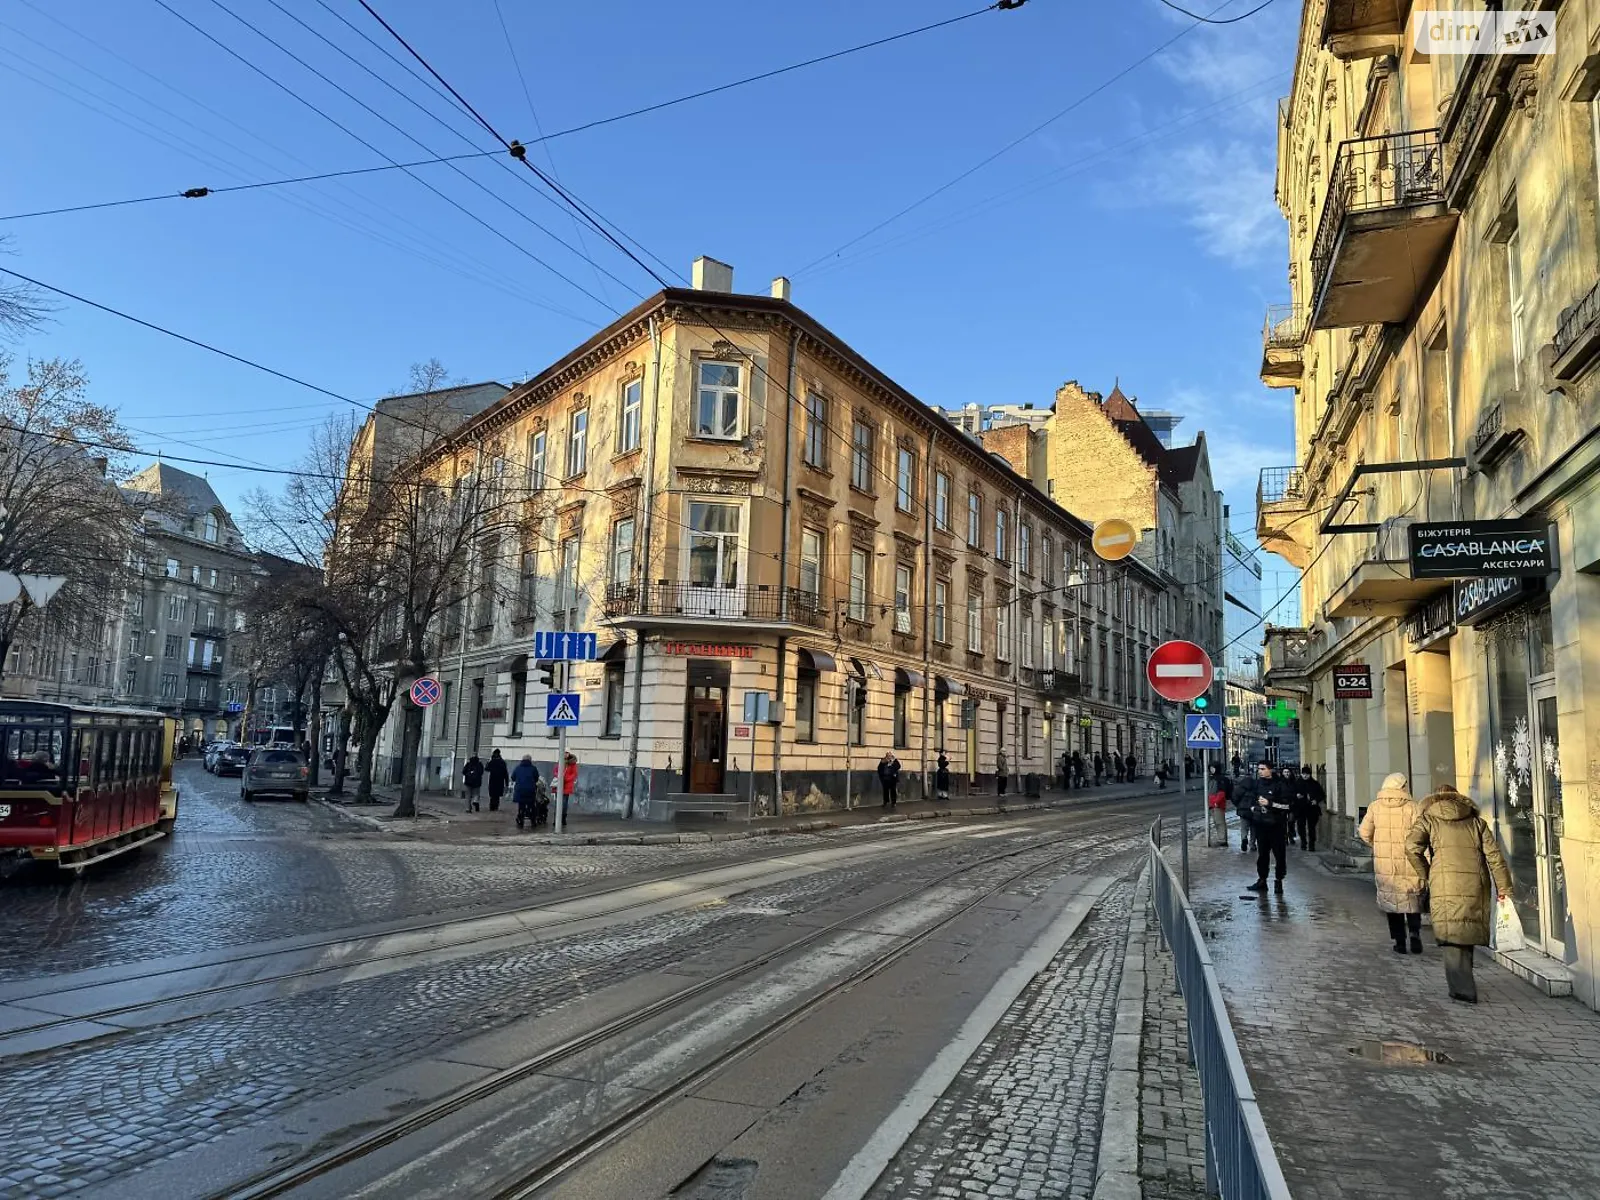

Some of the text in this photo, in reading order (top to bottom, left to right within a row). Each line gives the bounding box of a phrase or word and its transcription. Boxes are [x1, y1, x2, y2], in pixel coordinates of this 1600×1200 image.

[1417, 528, 1471, 538] БІЖУТЕРІЯ
[1420, 539, 1544, 558] CASABLANCA
[1482, 559, 1545, 569] АКСЕСУАРИ
[1337, 677, 1367, 687] 0-24
